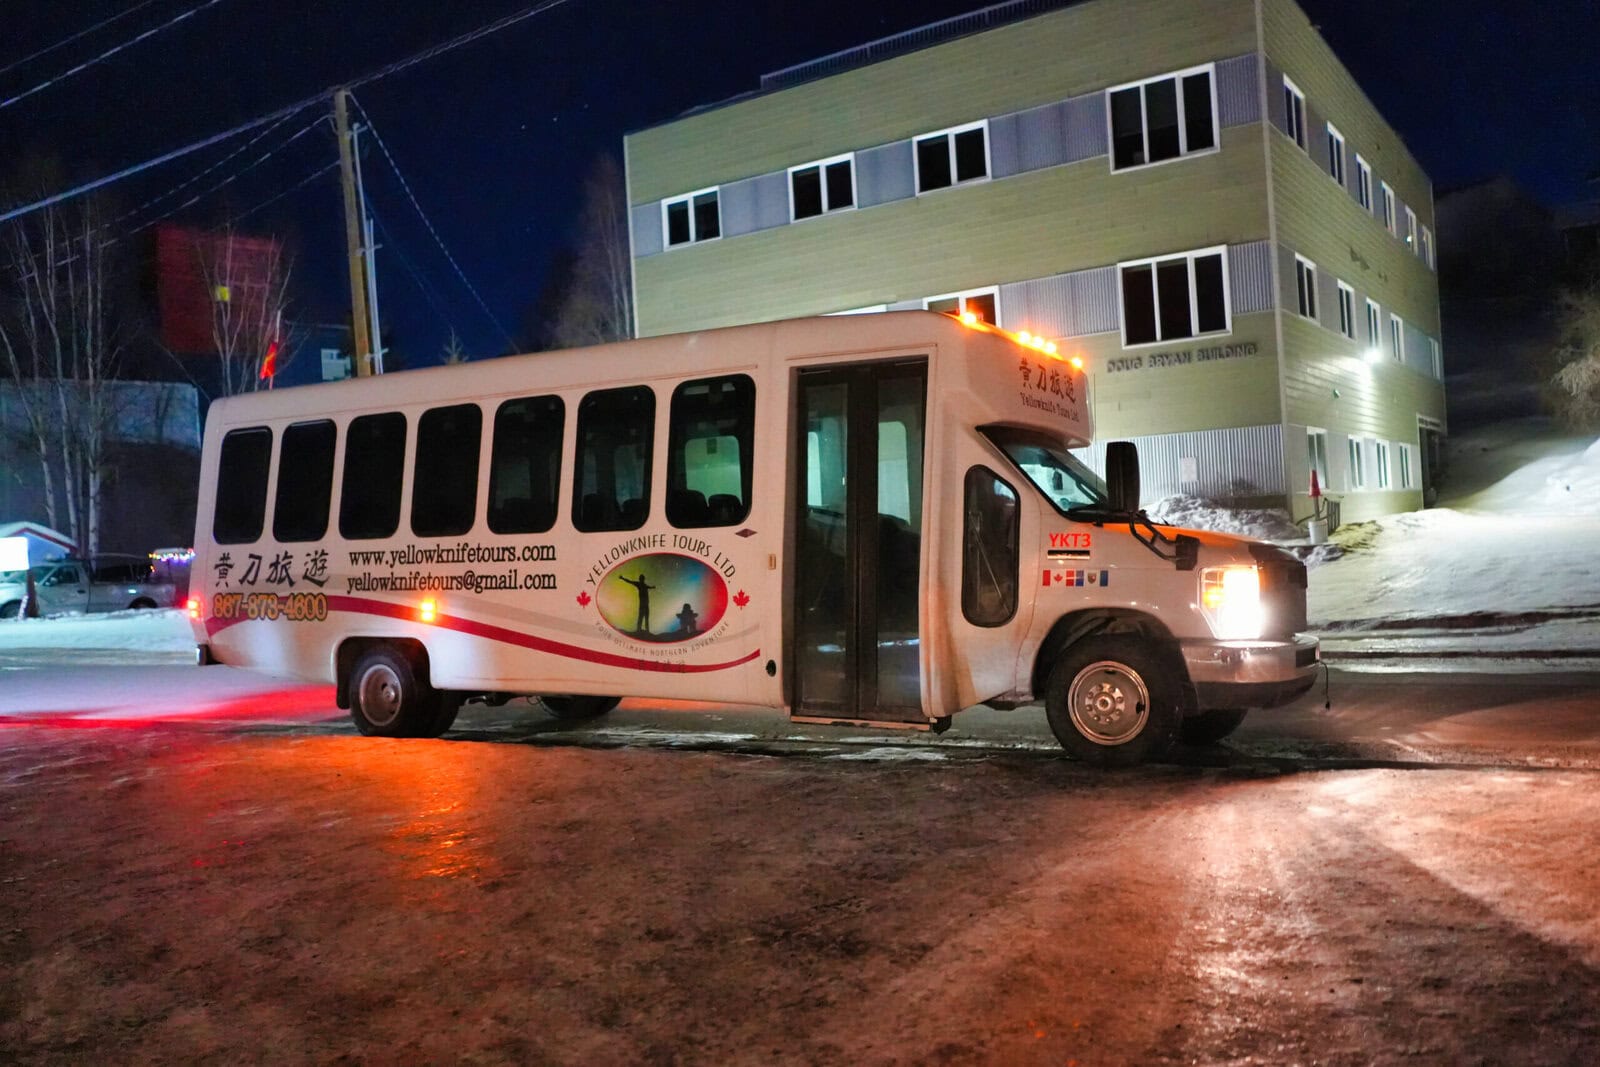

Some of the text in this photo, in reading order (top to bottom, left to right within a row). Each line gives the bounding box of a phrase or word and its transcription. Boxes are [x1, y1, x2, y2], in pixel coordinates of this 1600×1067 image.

[1107, 343, 1258, 373] DOUG BRYAN BUILDING
[1049, 533, 1092, 548] YKT3
[349, 543, 557, 568] www.yellowknifetours.com
[586, 534, 736, 586] YELLOWKNIFE TOURS LTD.
[347, 569, 557, 594] yellowknifetours@gmail.com
[691, 621, 729, 652] ADVENTURE
